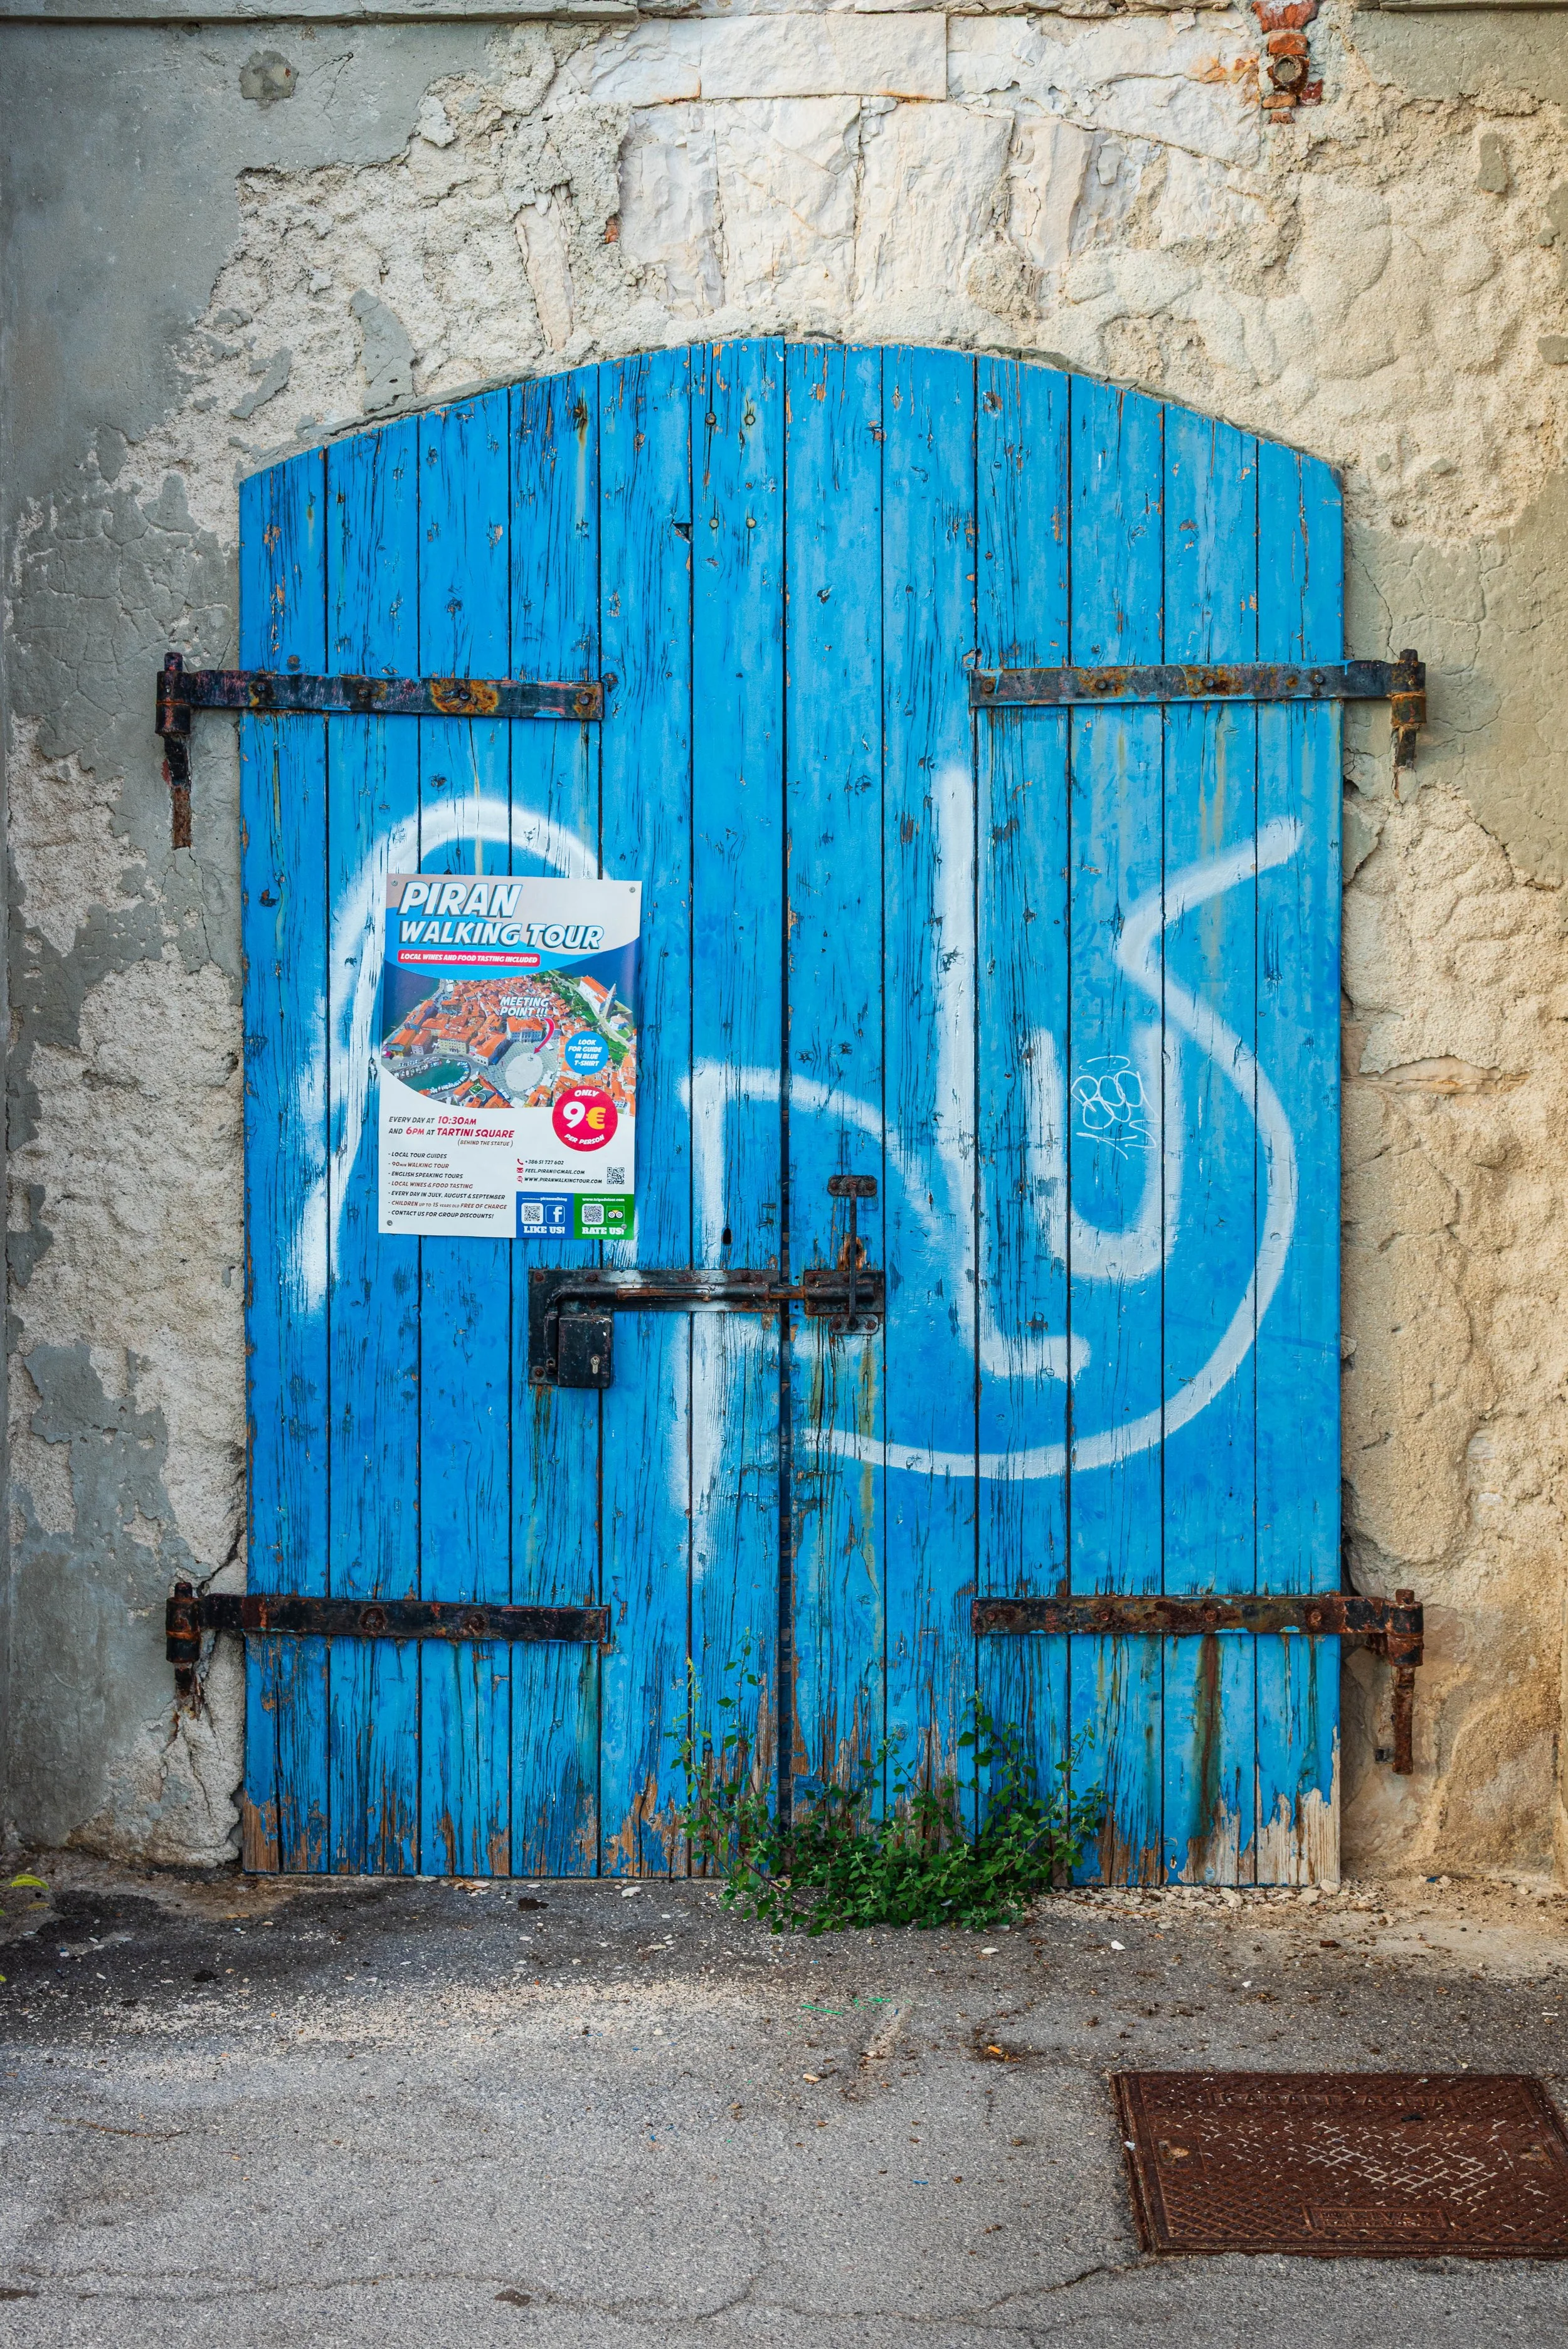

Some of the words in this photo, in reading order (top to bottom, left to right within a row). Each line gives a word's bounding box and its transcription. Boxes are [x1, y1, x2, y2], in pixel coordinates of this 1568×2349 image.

[397, 881, 522, 918] PIRAN
[400, 921, 522, 946] WALKING
[527, 923, 603, 949] TOUR
[500, 996, 549, 1007] MEETING
[499, 1006, 535, 1017] POINT
[574, 1089, 600, 1097] ONLY
[438, 1116, 477, 1125] 10:30AM
[406, 1127, 425, 1135] 6PM
[437, 1128, 474, 1137] TARTINI
[475, 1129, 515, 1138] SQUARE
[457, 1138, 479, 1147] (BEHIND
[564, 1133, 578, 1143] PER
[578, 1133, 605, 1145] PERSON
[523, 1226, 548, 1234] LIKE
[549, 1226, 566, 1234] US!
[581, 1227, 607, 1235] RATE
